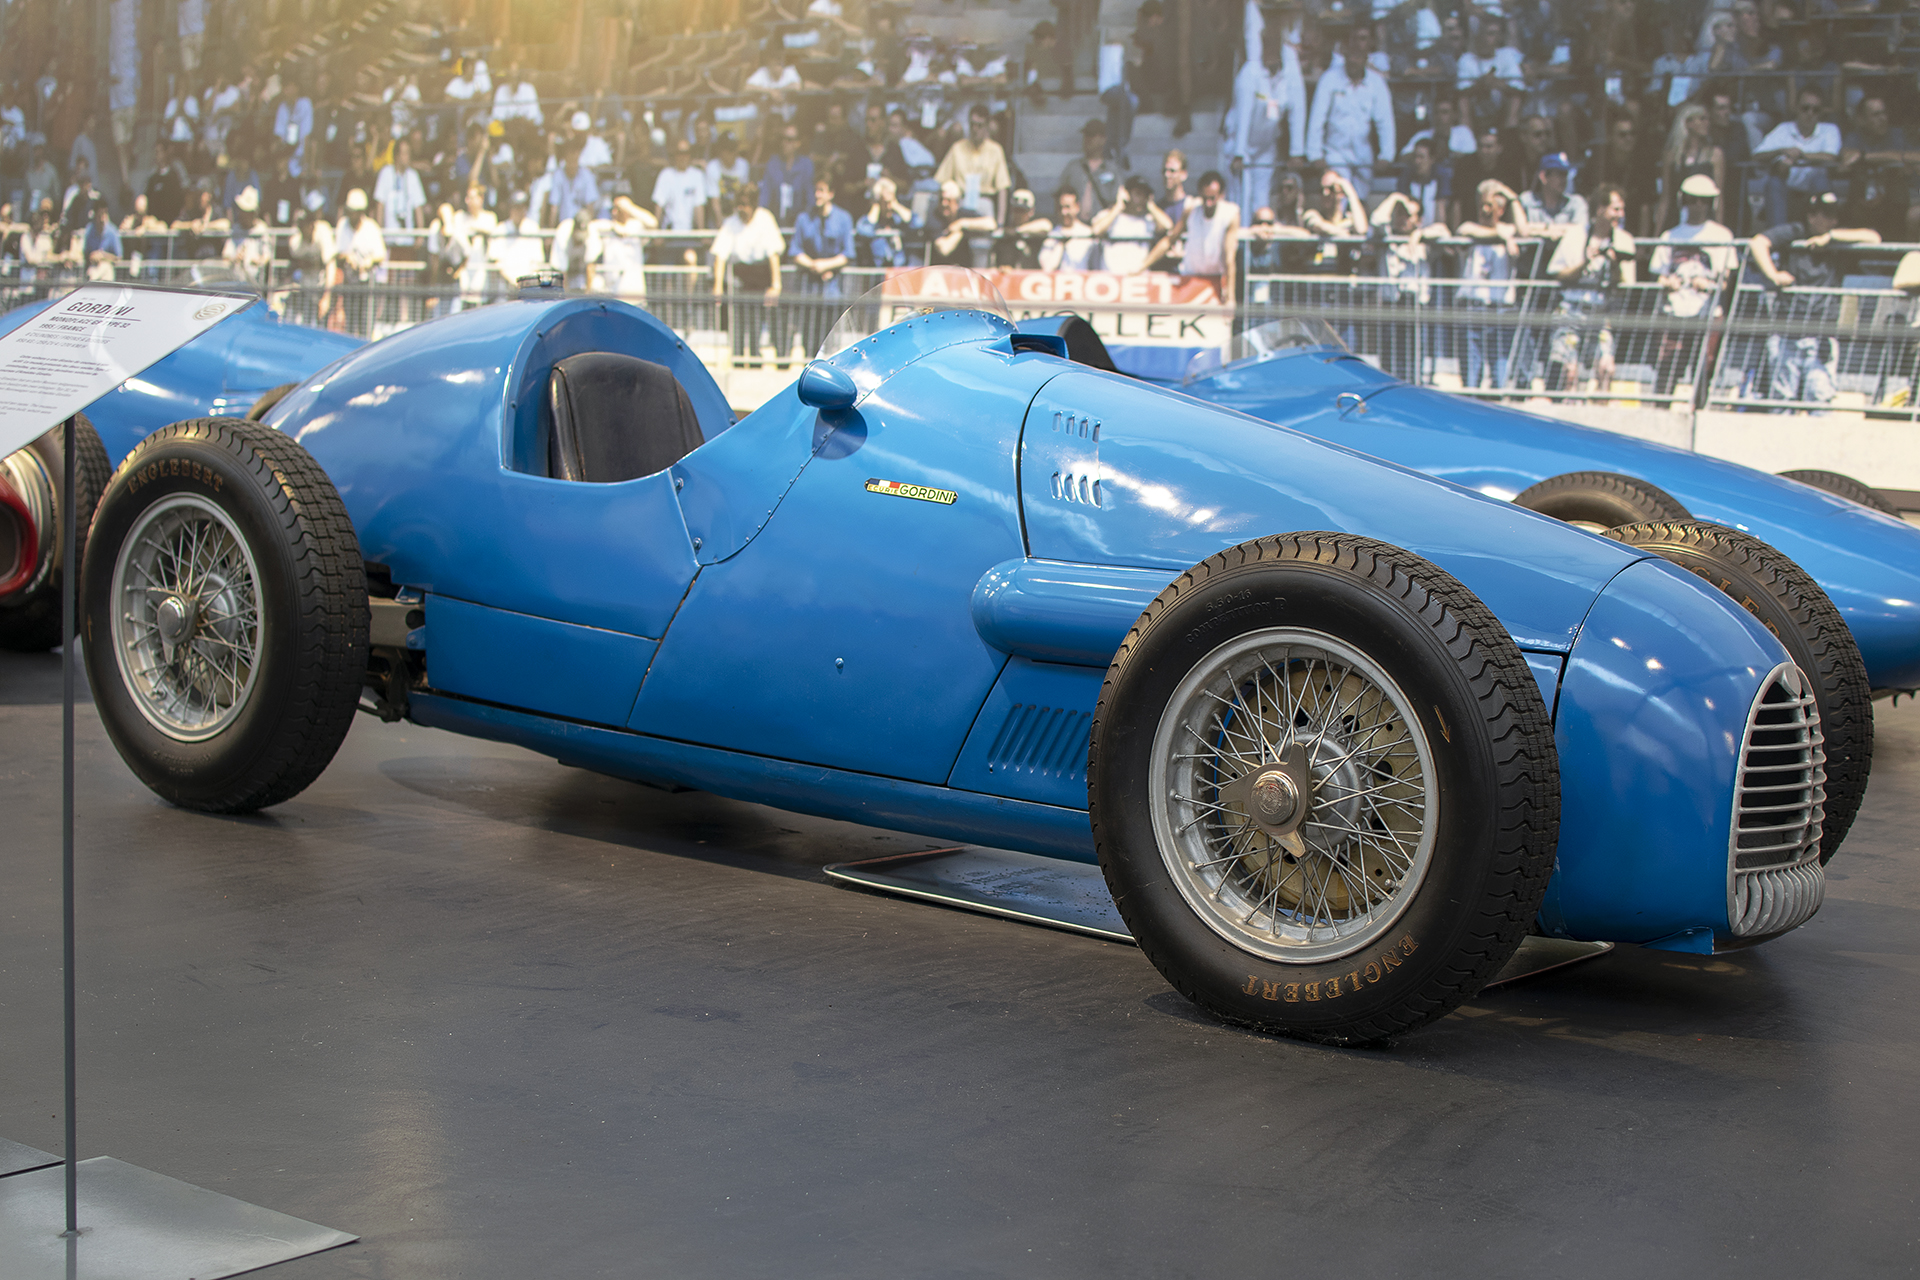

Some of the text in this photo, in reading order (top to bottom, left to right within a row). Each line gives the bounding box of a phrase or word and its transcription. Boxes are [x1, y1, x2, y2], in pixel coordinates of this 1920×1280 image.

[66, 302, 135, 317] GORDINI
[58, 324, 87, 332] FRANCE
[127, 458, 223, 494] ENGLEBERT
[868, 484, 953, 503] ECURIE GORDINI
[1241, 930, 1419, 1003] ENGLEBERT
